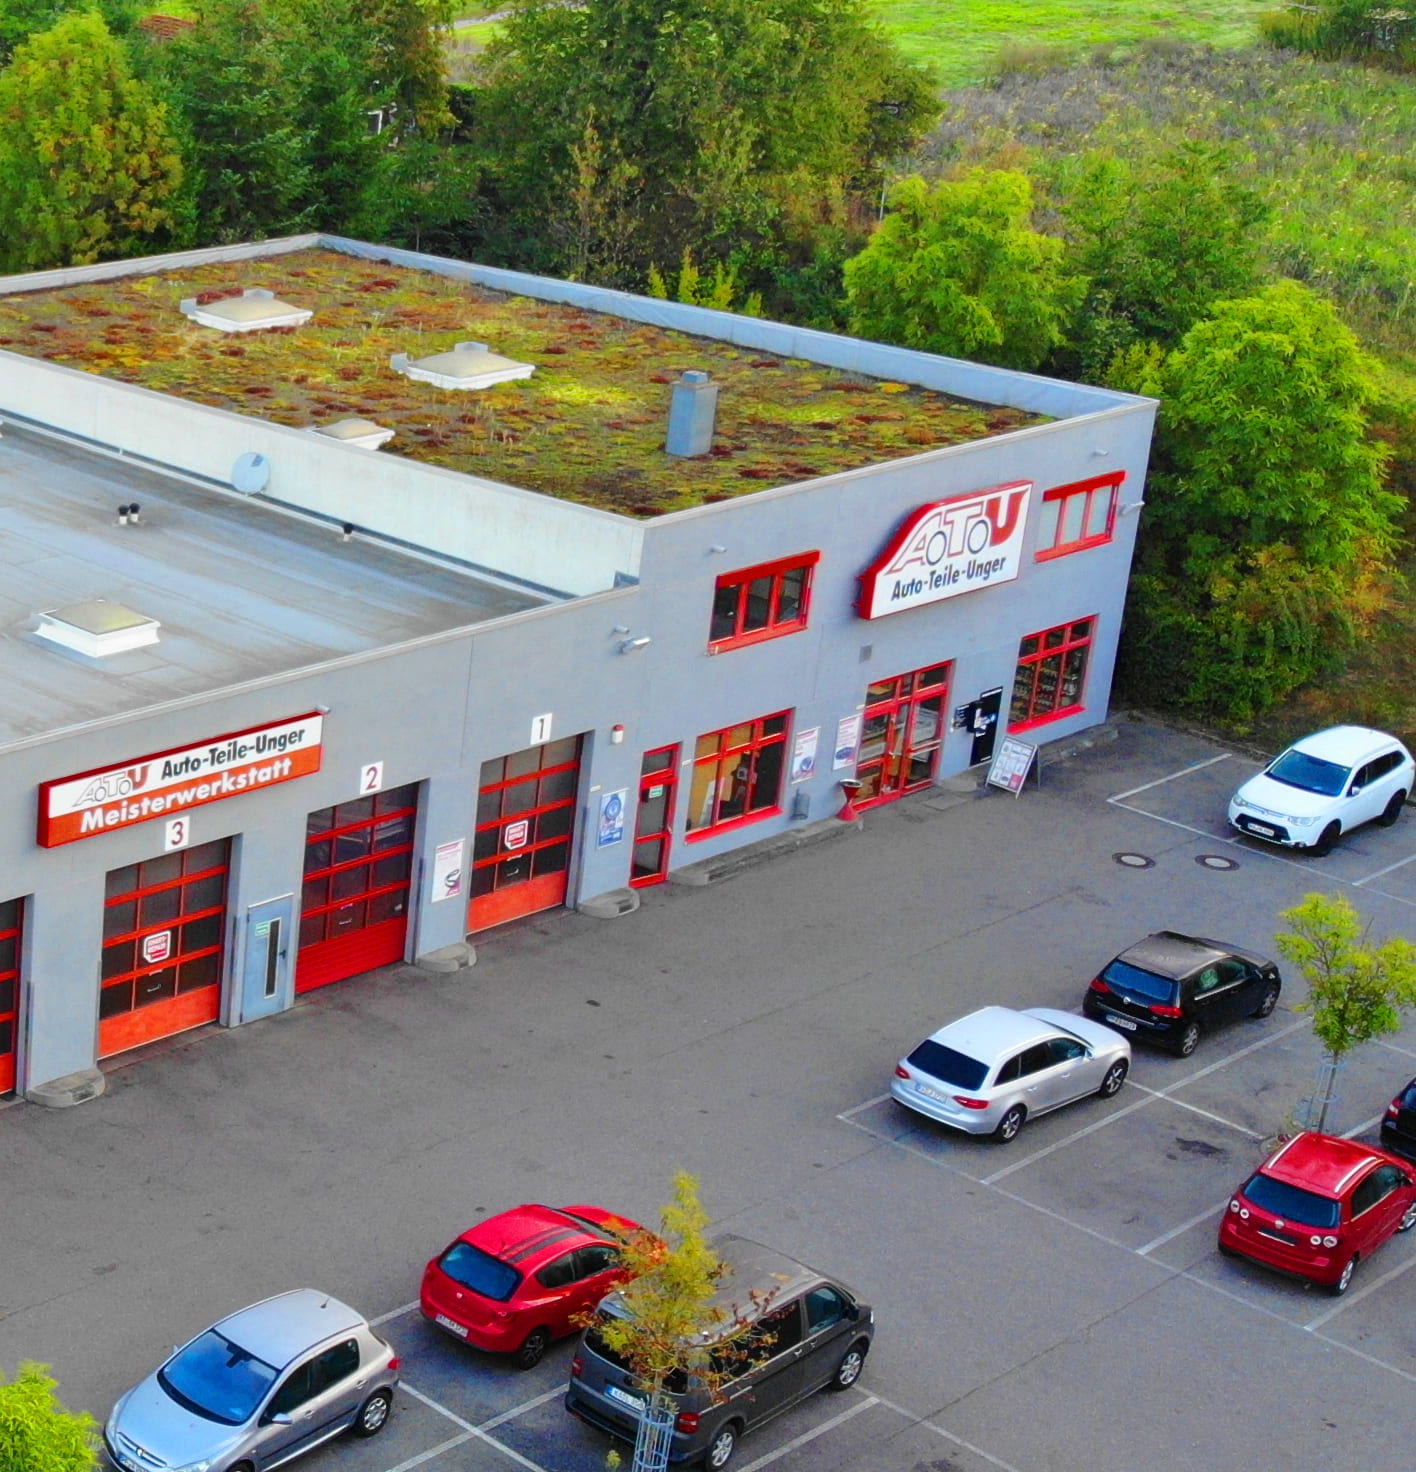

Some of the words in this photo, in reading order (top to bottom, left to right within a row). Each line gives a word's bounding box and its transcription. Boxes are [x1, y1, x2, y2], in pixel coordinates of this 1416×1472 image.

[891, 557, 1007, 601] Auto-Teile-Unger
[539, 718, 545, 740] 1
[161, 729, 305, 780] Auto-Teile-Unger
[366, 766, 378, 790] 2
[80, 759, 292, 833] Meisterwerkstatt
[171, 821, 184, 845] 3
